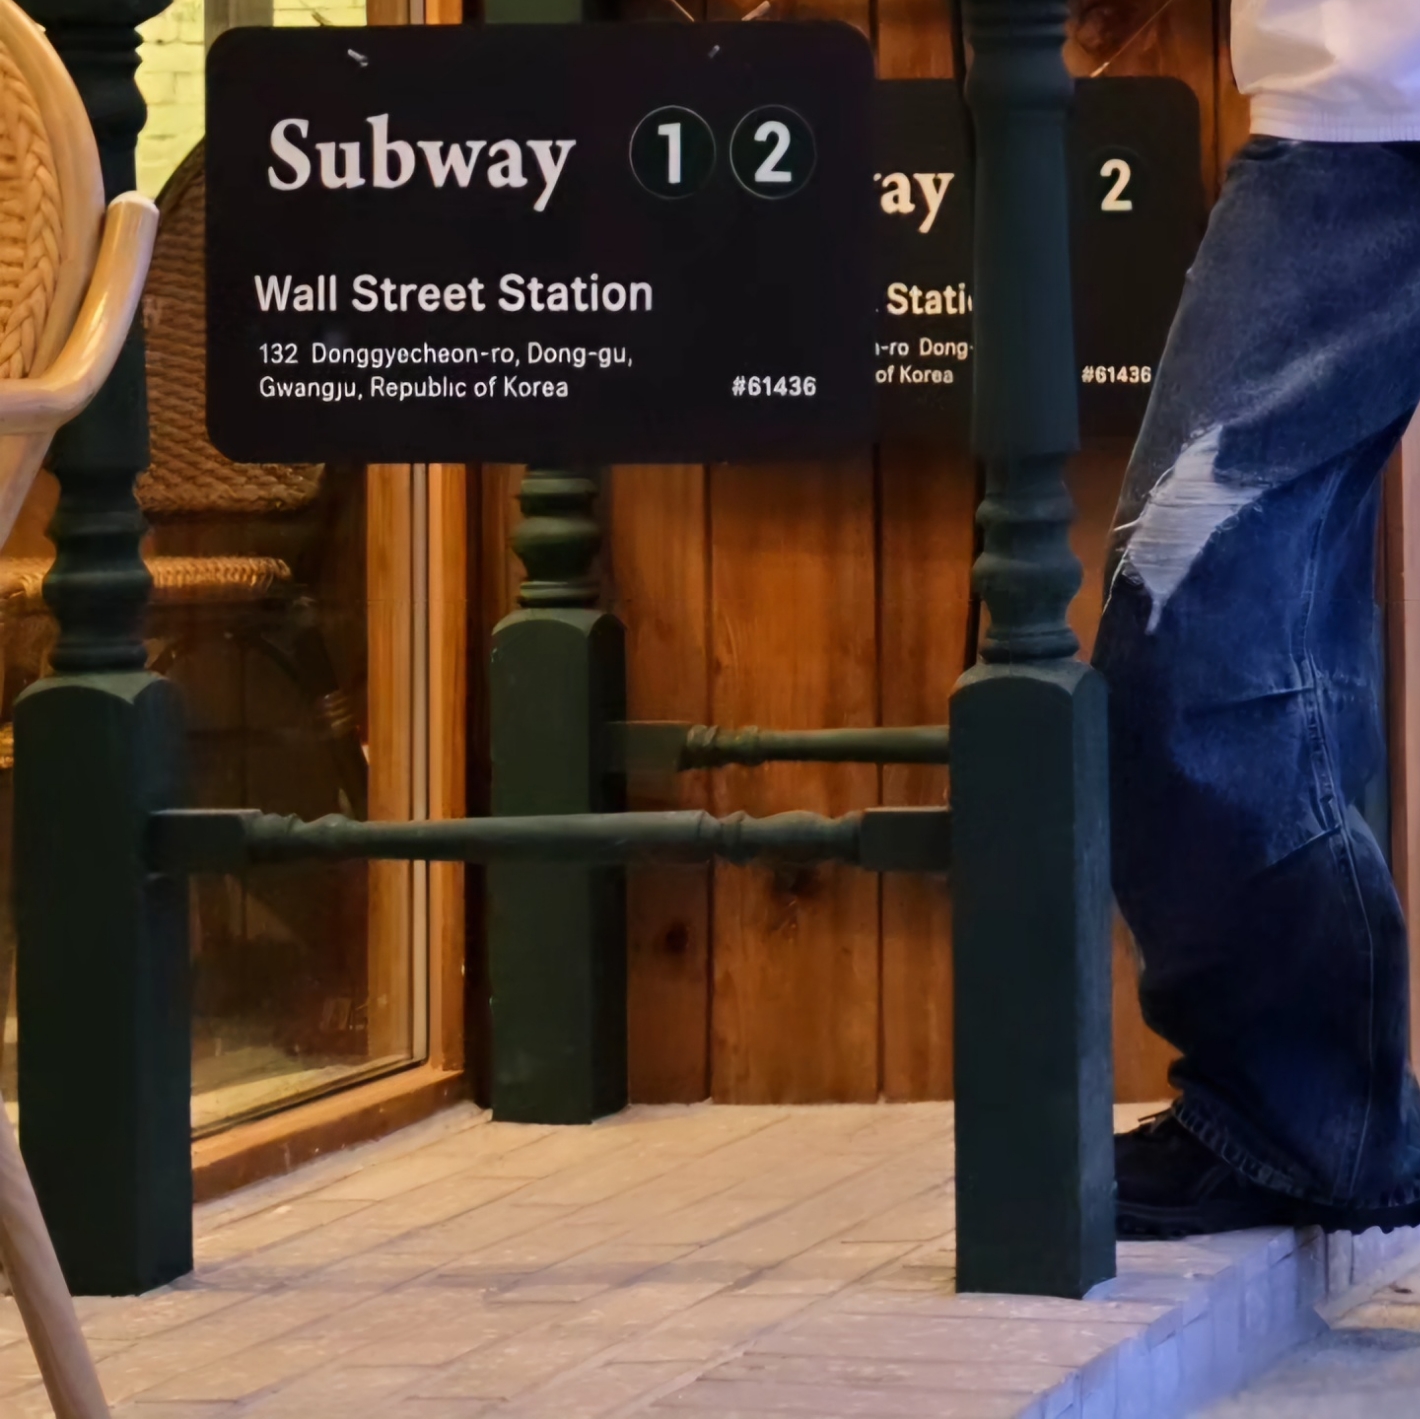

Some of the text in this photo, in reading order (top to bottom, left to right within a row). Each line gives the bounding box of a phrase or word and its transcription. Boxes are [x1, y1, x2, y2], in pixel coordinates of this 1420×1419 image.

[268, 113, 793, 212] Subway 1 2
[873, 158, 1133, 234] ay 2
[254, 273, 653, 313] Wall Street Station
[258, 341, 634, 369] 132 Donggyecheon-ro, Dong-gu,
[259, 375, 817, 402] Gwangju, Republic of Korea #61436
[875, 364, 1152, 384] of Korea #61436
